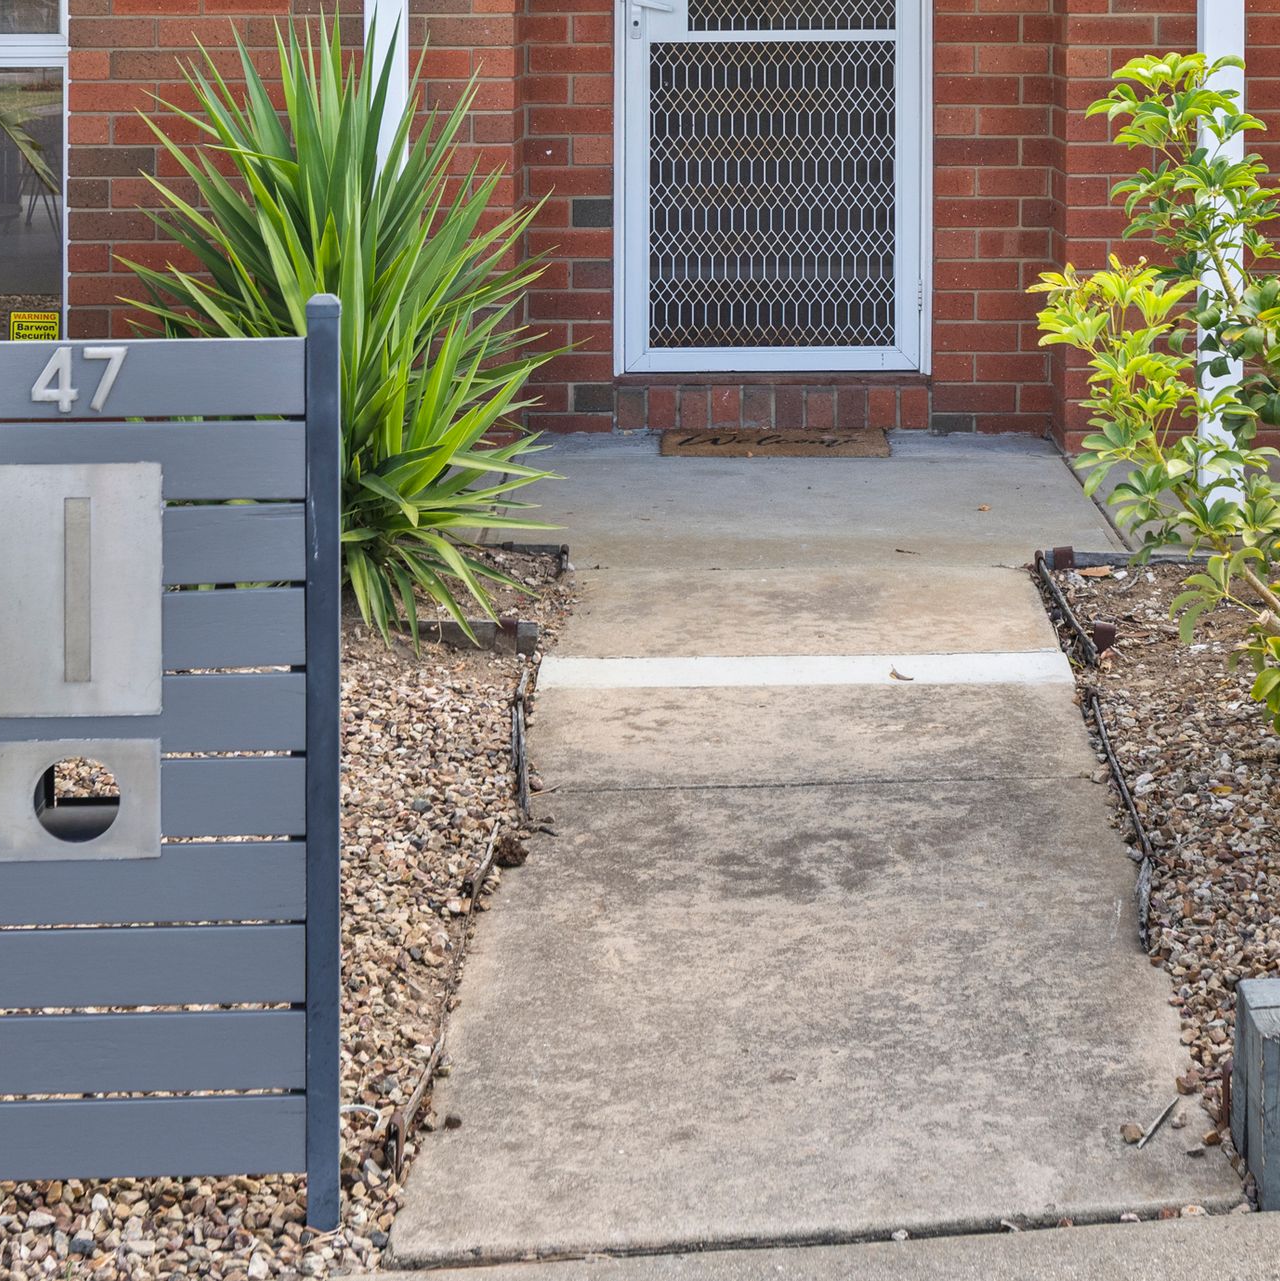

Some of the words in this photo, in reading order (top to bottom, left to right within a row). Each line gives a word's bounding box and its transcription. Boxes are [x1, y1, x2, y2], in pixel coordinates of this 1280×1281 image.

[13, 313, 57, 321] WARNING
[16, 323, 55, 331] Barwon
[15, 331, 57, 340] Security
[31, 346, 128, 413] 47
